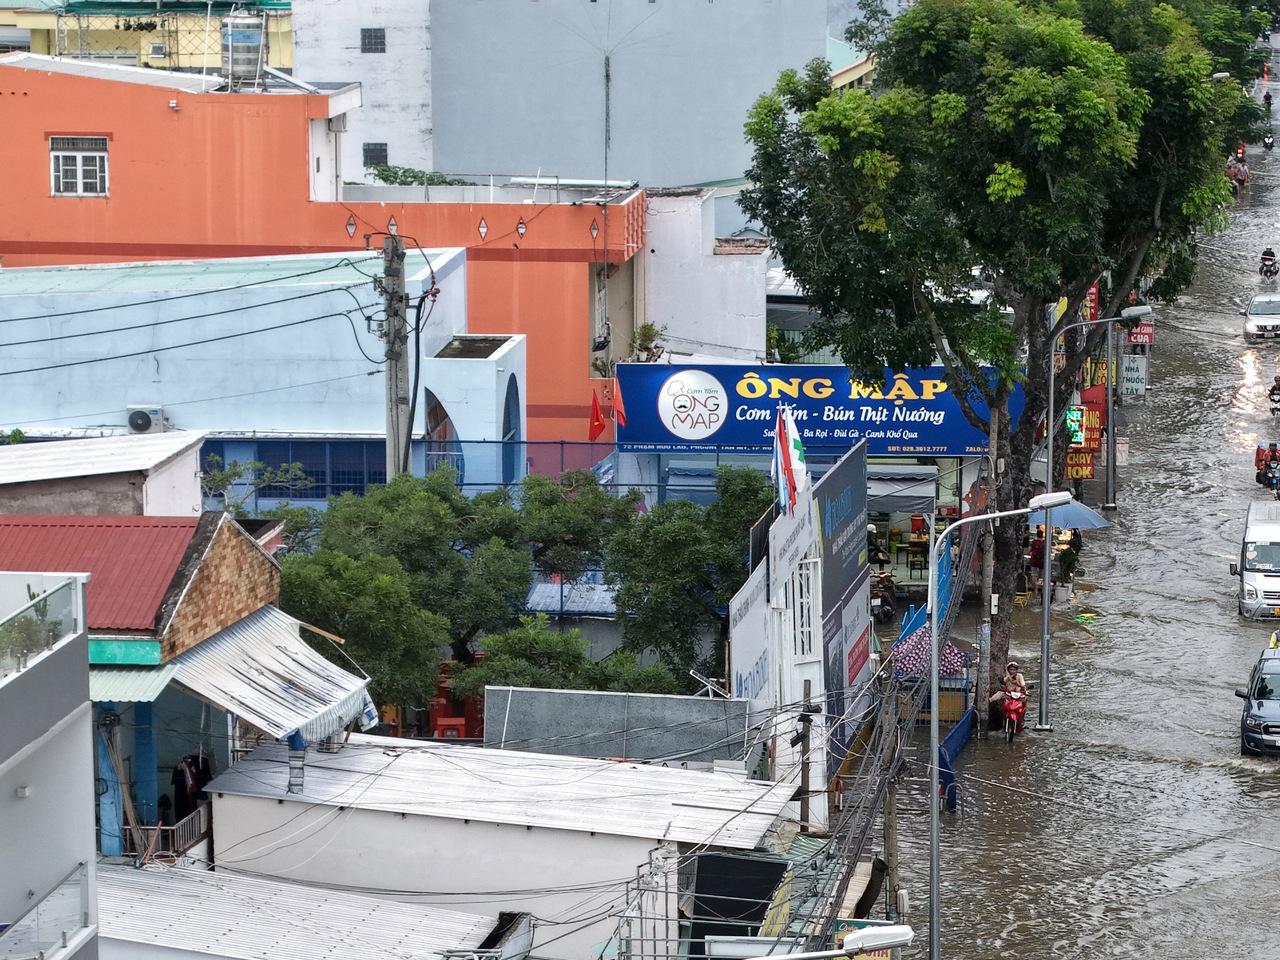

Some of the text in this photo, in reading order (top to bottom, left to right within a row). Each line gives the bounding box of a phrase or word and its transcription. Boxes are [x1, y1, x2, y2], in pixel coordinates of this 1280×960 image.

[735, 371, 948, 405] ÔNG MẬP
[735, 404, 771, 421] Cơm
[822, 405, 855, 421] Bún
[859, 406, 889, 425] Thịt
[892, 406, 945, 425] Nướng
[803, 429, 814, 437] Ba
[865, 429, 885, 438] Canh
[902, 430, 918, 440] Qua
[1066, 453, 1093, 465] CHAY
